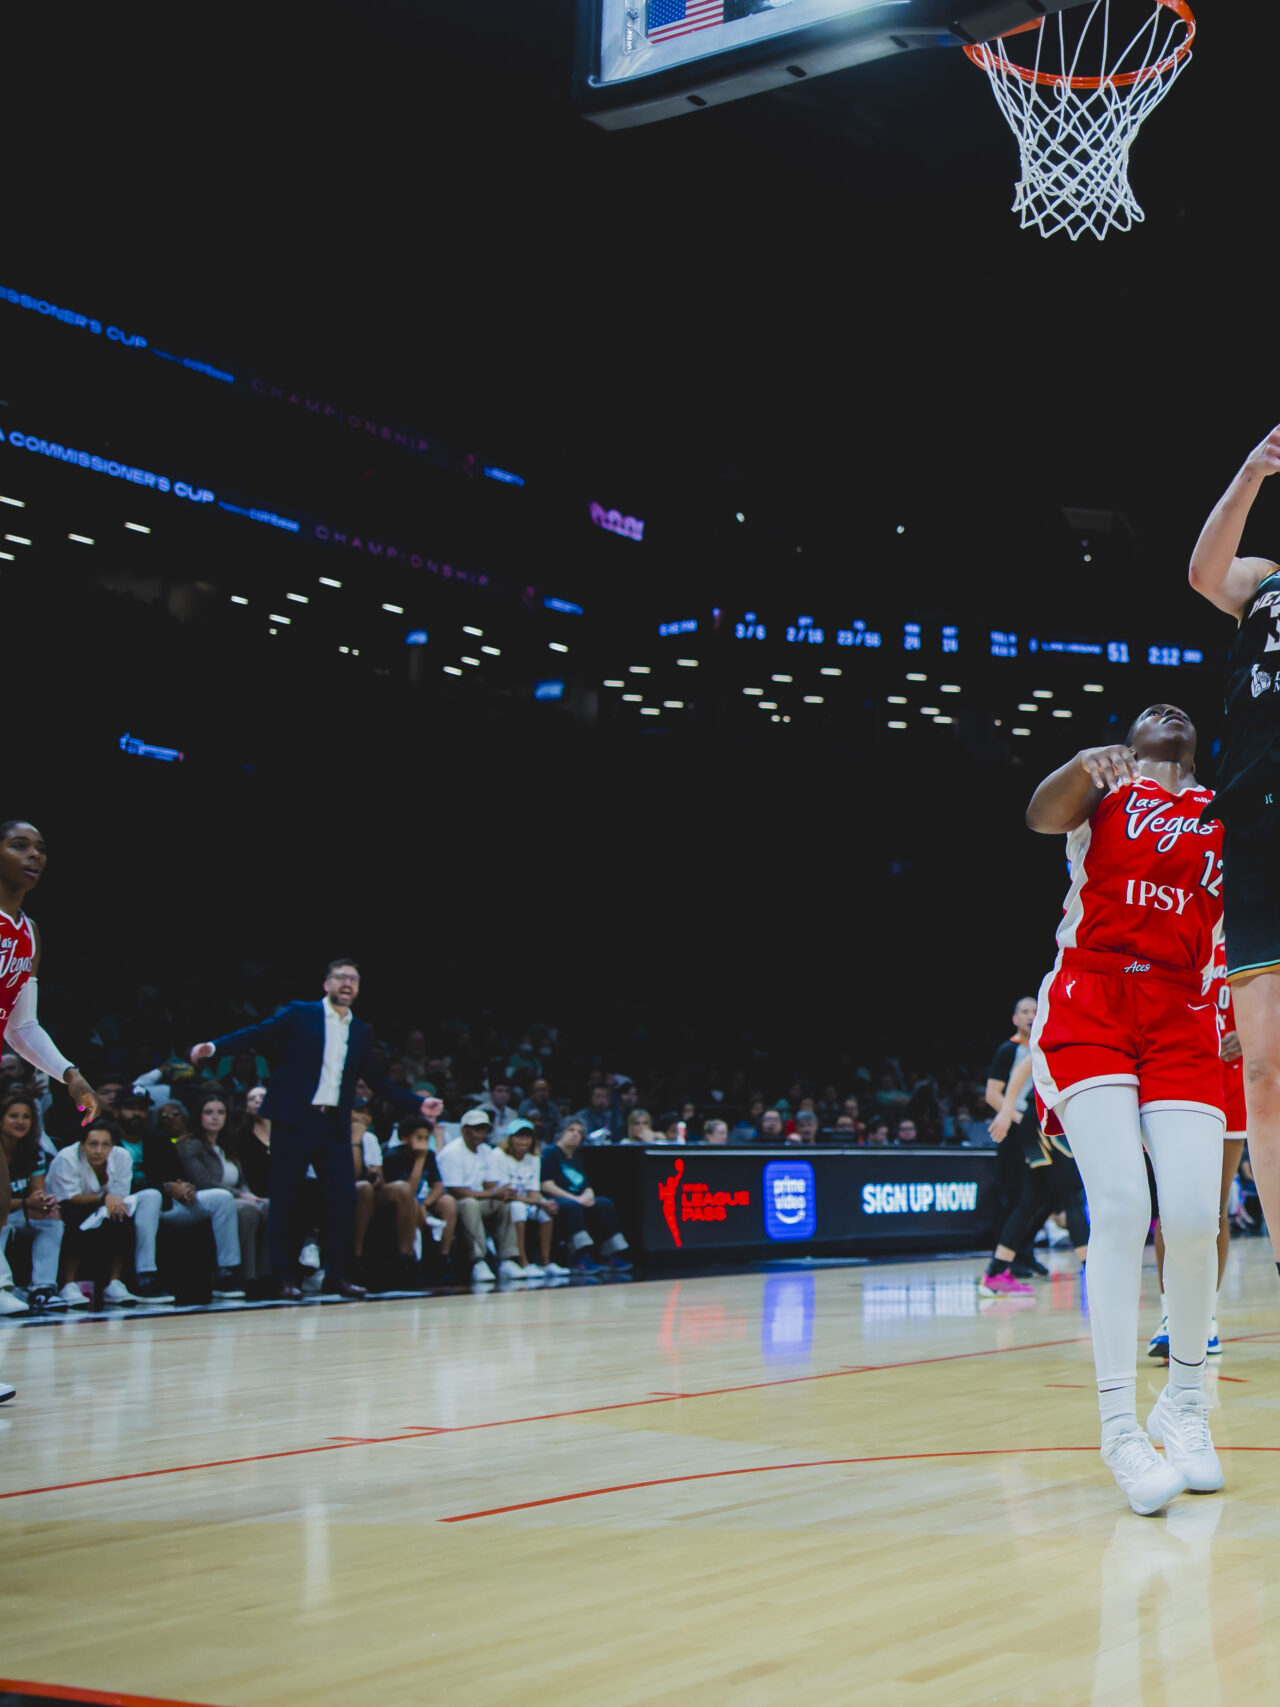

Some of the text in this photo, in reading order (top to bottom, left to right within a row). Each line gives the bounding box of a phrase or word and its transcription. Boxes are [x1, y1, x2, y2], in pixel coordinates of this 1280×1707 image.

[106, 325, 148, 348] CUP
[173, 481, 215, 504] CUP
[316, 525, 490, 587] CHAMPIONSHIP
[1107, 641, 1130, 663] 51
[1148, 646, 1180, 666] 2:12
[1124, 791, 1163, 815] Las
[1126, 802, 1219, 854] Vegas
[1199, 850, 1224, 898] 12
[1125, 879, 1194, 915] IPSY
[1122, 961, 1151, 974] Aces
[681, 1190, 750, 1207] LEAGUE
[862, 1181, 978, 1215] SIGN UP NOW
[681, 1206, 727, 1222] PASS
